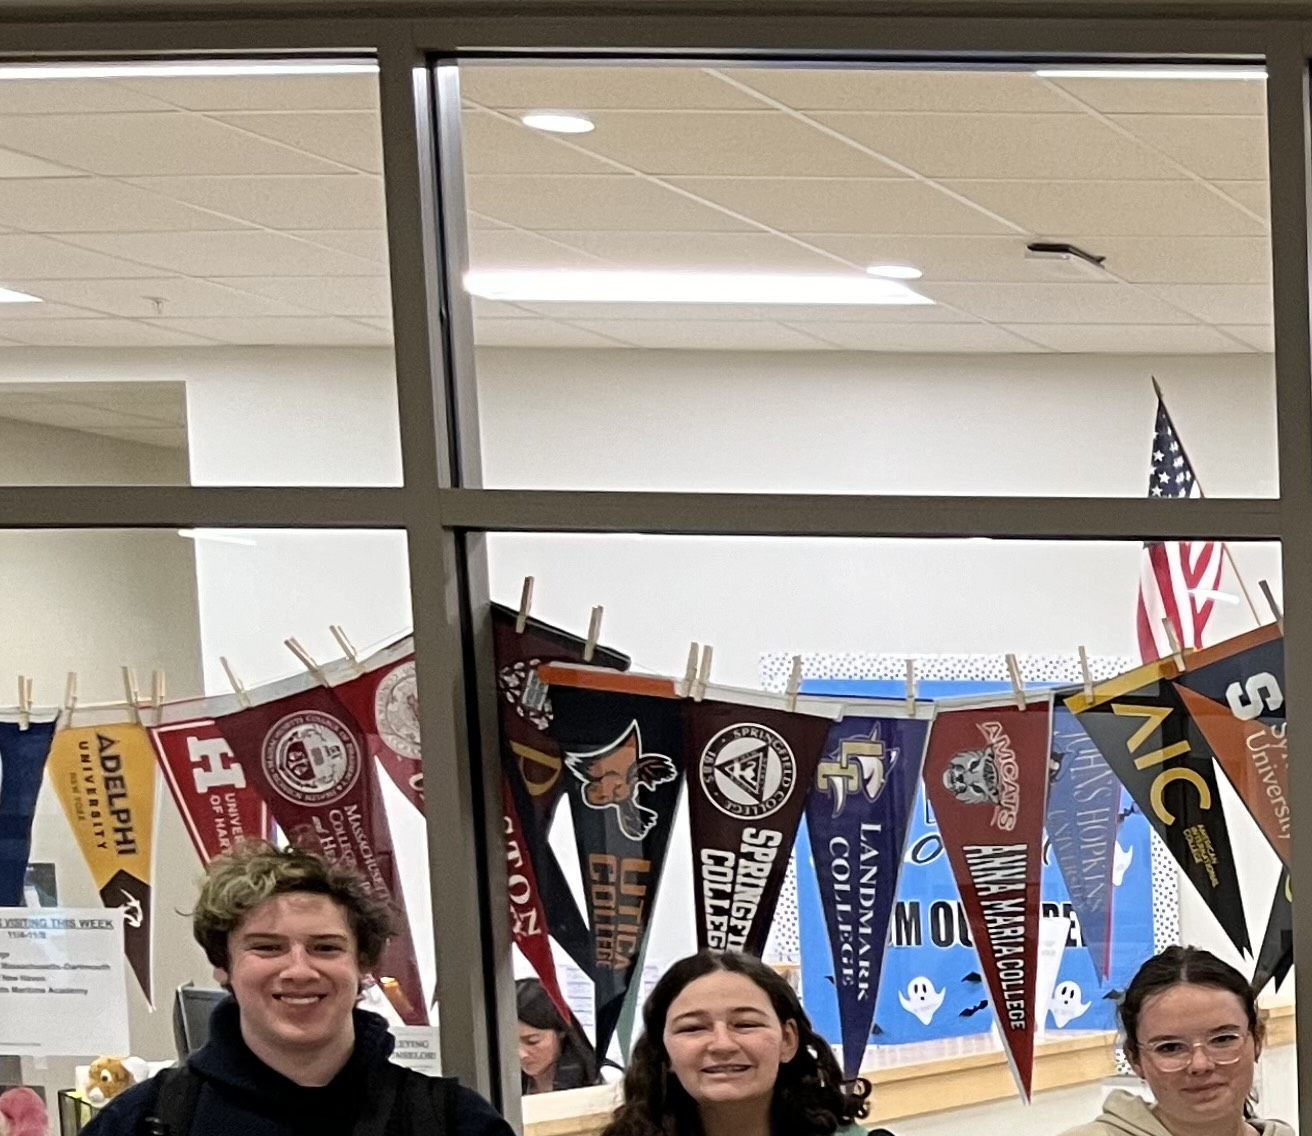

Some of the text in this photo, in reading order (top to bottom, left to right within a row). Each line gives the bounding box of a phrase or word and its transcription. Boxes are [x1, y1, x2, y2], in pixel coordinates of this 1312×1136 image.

[1225, 672, 1284, 721] S
[78, 741, 107, 849] UNIVERSITY
[96, 733, 137, 855] ADELPHI
[209, 795, 224, 814] OF
[726, 790, 785, 818] COLLEGE
[733, 726, 793, 789] SPRINGFIELD
[977, 721, 1020, 832] AMCATS
[588, 853, 618, 968] COLLEGE
[613, 857, 651, 970] UTICA
[829, 836, 854, 986] COLLEGE
[858, 822, 882, 1001] LANDMARK
[1075, 806, 1110, 912] HOPKINS
[79, 919, 114, 930] WEEK
[962, 844, 1028, 1031] ANNA MARIA COLLEGE
